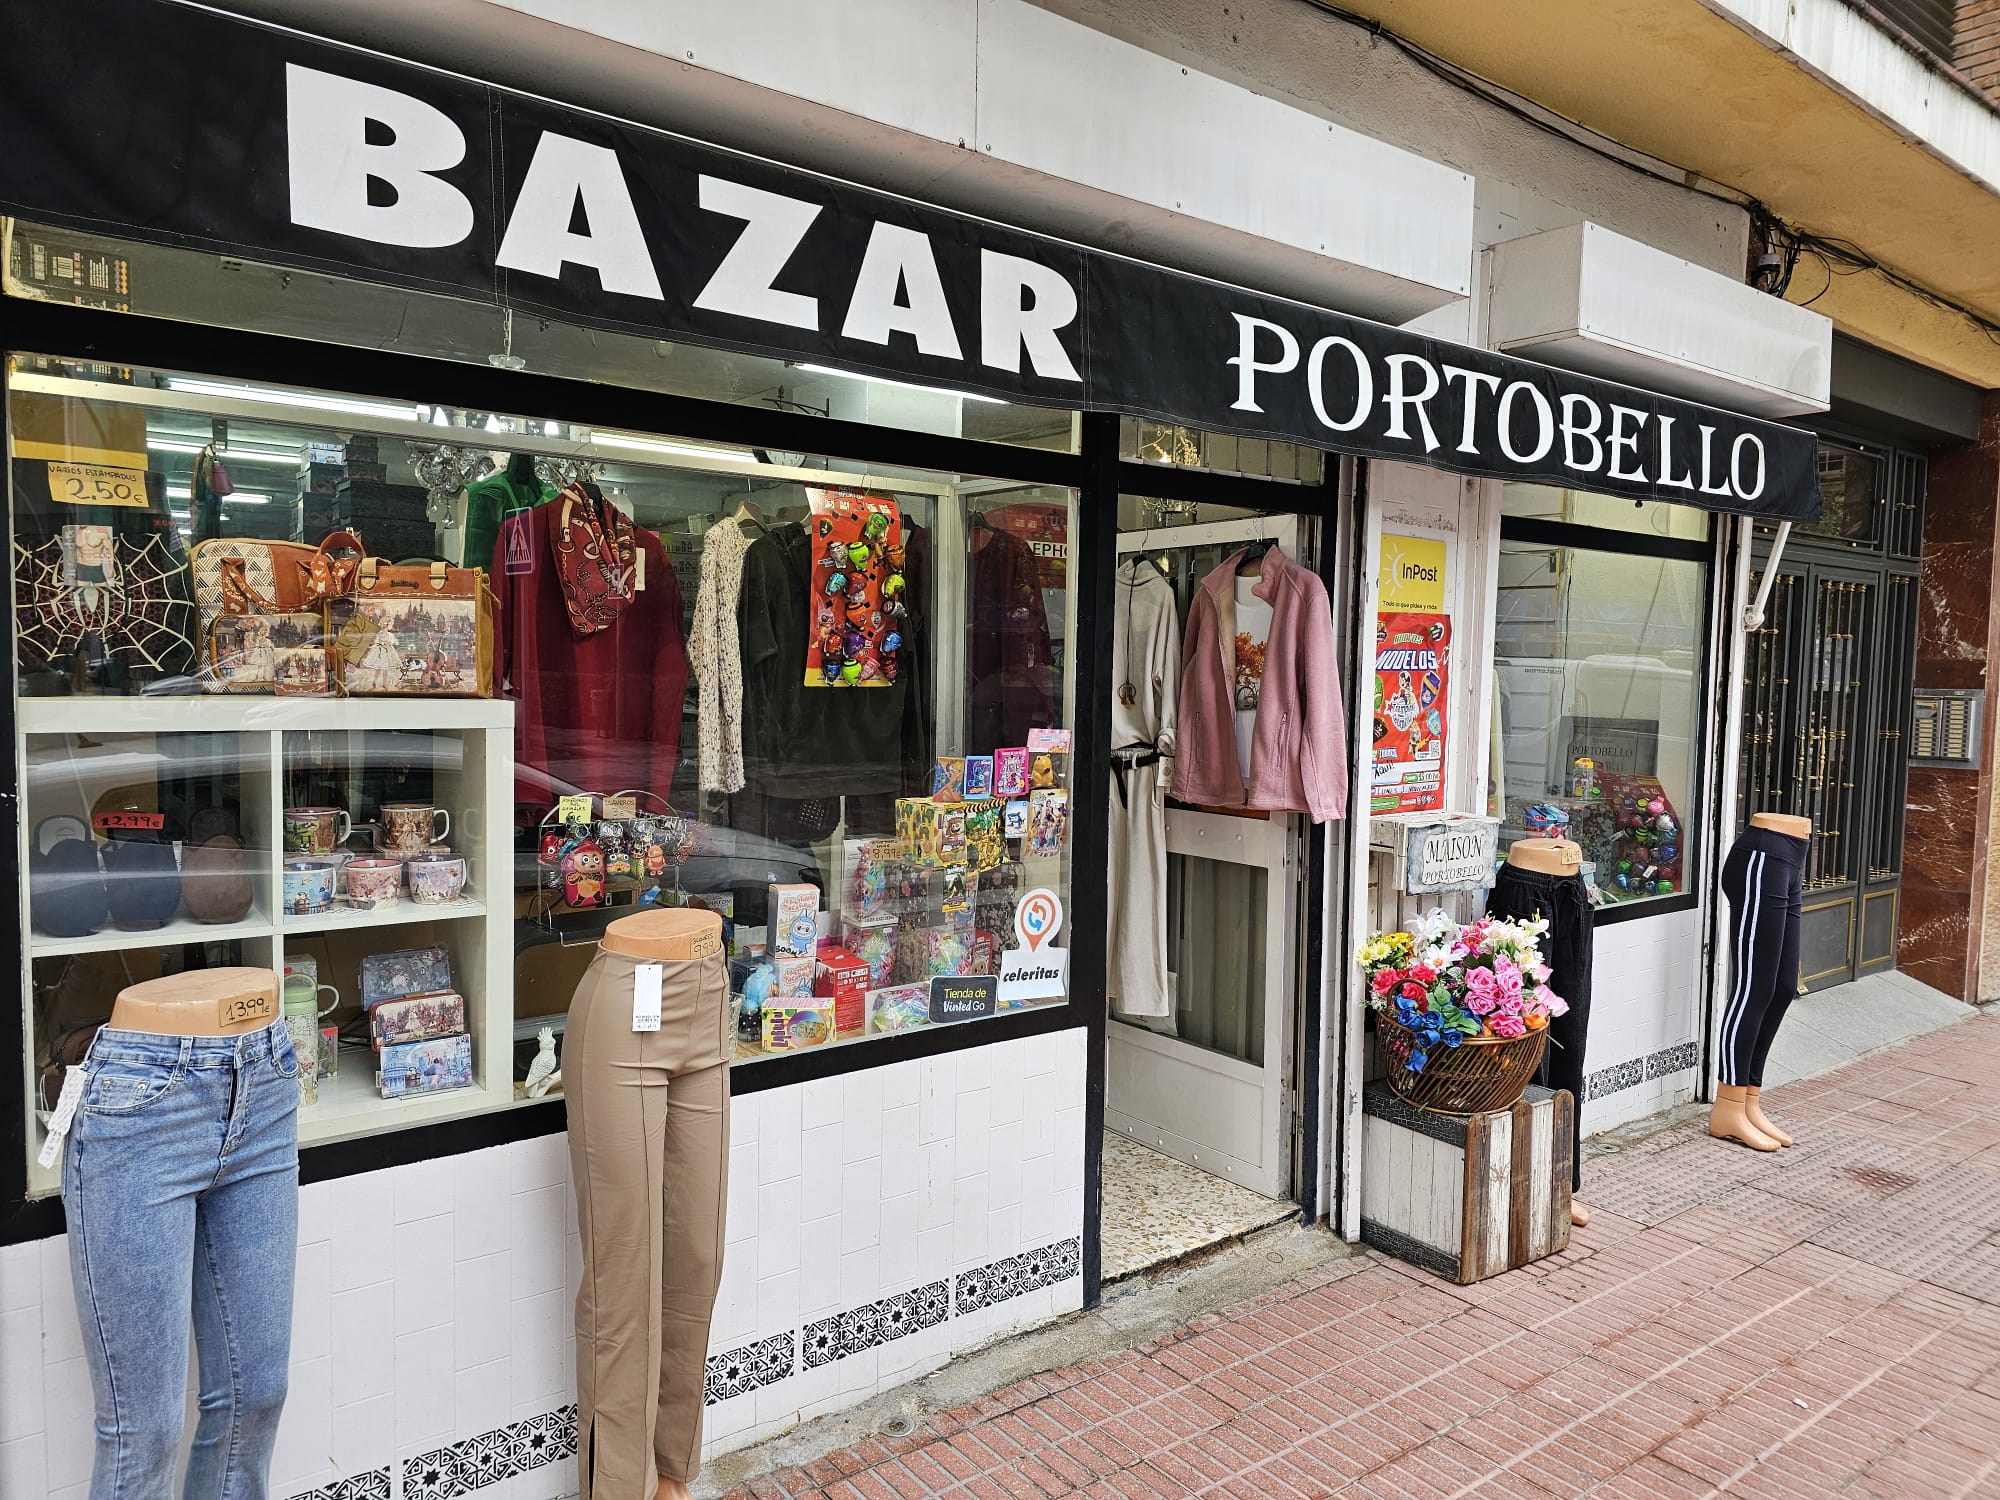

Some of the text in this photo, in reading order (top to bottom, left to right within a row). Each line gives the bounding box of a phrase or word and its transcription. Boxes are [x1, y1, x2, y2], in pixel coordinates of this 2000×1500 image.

[286, 62, 1083, 382] BAZAR
[1226, 312, 1766, 501] PORTOBELLO
[48, 465, 137, 482] VARIOS ESTAMPADOS
[1032, 542, 1067, 557] EPH
[1402, 563, 1438, 582] InPost
[1376, 649, 1437, 670] MODELOS
[1572, 745, 1633, 758] PORTOBELLO
[1426, 834, 1484, 863] MAISON
[1424, 864, 1484, 883] PORTOBELLO
[1003, 966, 1060, 983] celeritas
[944, 988, 987, 999] Tienda de
[943, 1001, 985, 1012] Vinted Go
